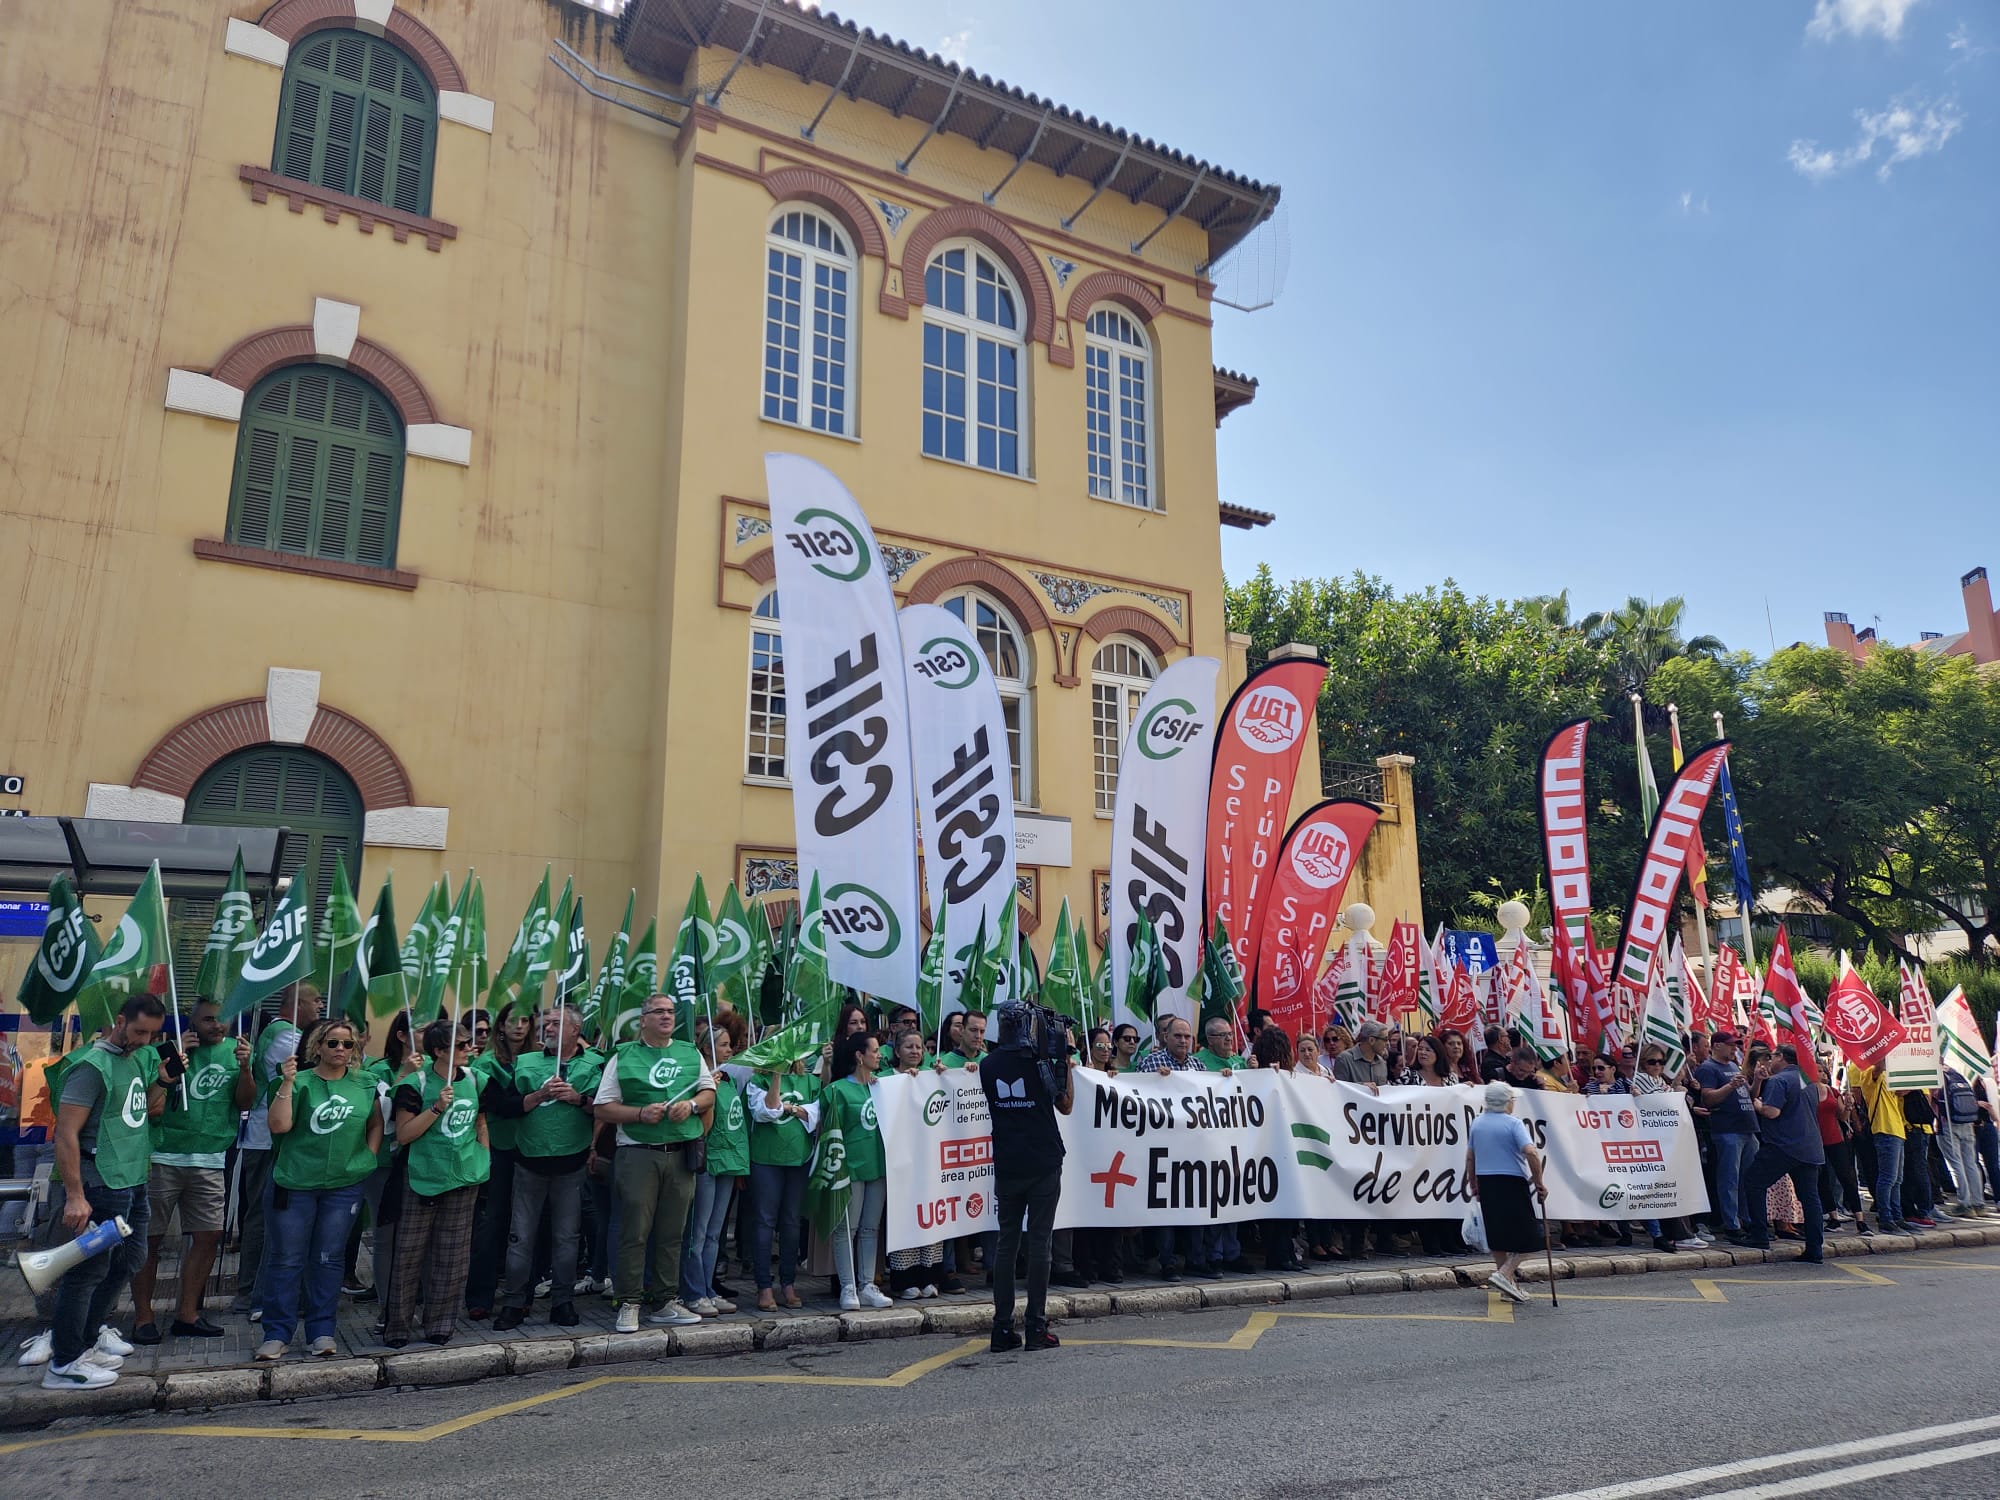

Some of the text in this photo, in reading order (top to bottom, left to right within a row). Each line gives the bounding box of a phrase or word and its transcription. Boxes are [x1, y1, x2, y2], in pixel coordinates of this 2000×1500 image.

[1251, 694, 1297, 727] UGT
[1150, 716, 1204, 743] CSIF
[1302, 828, 1347, 861] UGT
[1544, 758, 1591, 910] CCOO
[1630, 778, 1709, 944] CCOO
[49, 906, 84, 972] CSIF
[252, 905, 308, 960] CSIF
[1401, 927, 1416, 988] UGT
[1716, 948, 1734, 1001] UGT
[1838, 993, 1878, 1032] UGT
[1859, 1029, 1899, 1060] www.ugt.es
[198, 1073, 231, 1088] CSIF
[655, 1065, 683, 1079] CSIF
[320, 1105, 354, 1122] CSIF
[929, 1099, 951, 1115] CSIF
[1011, 1100, 1036, 1108] Málaga
[1094, 1084, 1265, 1137] Mejor salario
[1640, 1109, 1680, 1118] Servicios
[449, 1107, 475, 1126] CSIF
[957, 1115, 969, 1124] de
[1343, 1102, 1459, 1146] Servicios
[1575, 1110, 1613, 1129] UGT
[1642, 1119, 1679, 1128] Públicos
[1606, 1144, 1659, 1160] CCOO
[941, 1171, 965, 1183] área
[1353, 1151, 1402, 1204] de
[1608, 1163, 1666, 1174] área pública
[1147, 1145, 1279, 1219] Empleo
[1627, 1181, 1677, 1191] Central Sindical
[1605, 1191, 1625, 1201] CSIF
[1638, 1200, 1678, 1209] Funcionarios
[917, 1196, 961, 1230] UGT
